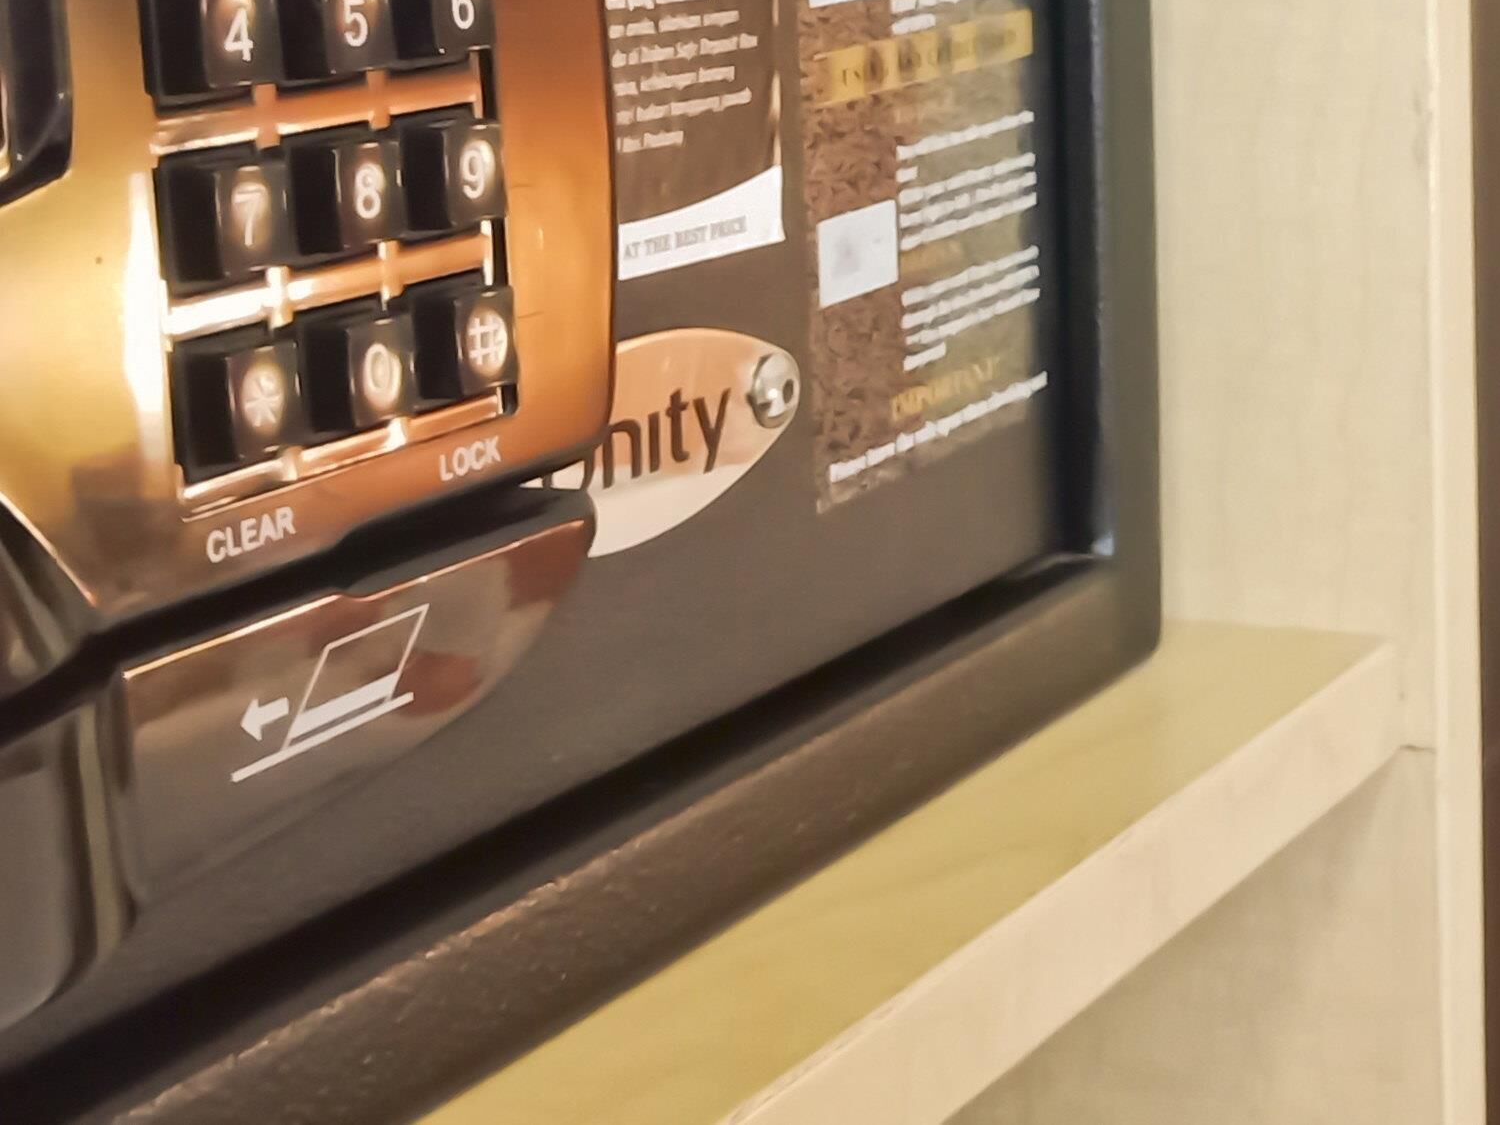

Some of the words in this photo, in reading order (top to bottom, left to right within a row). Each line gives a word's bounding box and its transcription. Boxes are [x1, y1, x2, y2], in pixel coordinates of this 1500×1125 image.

[224, 8, 254, 62] 4
[234, 187, 262, 246] 7
[354, 165, 382, 220] 8
[459, 146, 488, 199] 9
[363, 343, 393, 405] 0
[438, 436, 501, 482] LOCK
[206, 506, 296, 563] CLEAR
